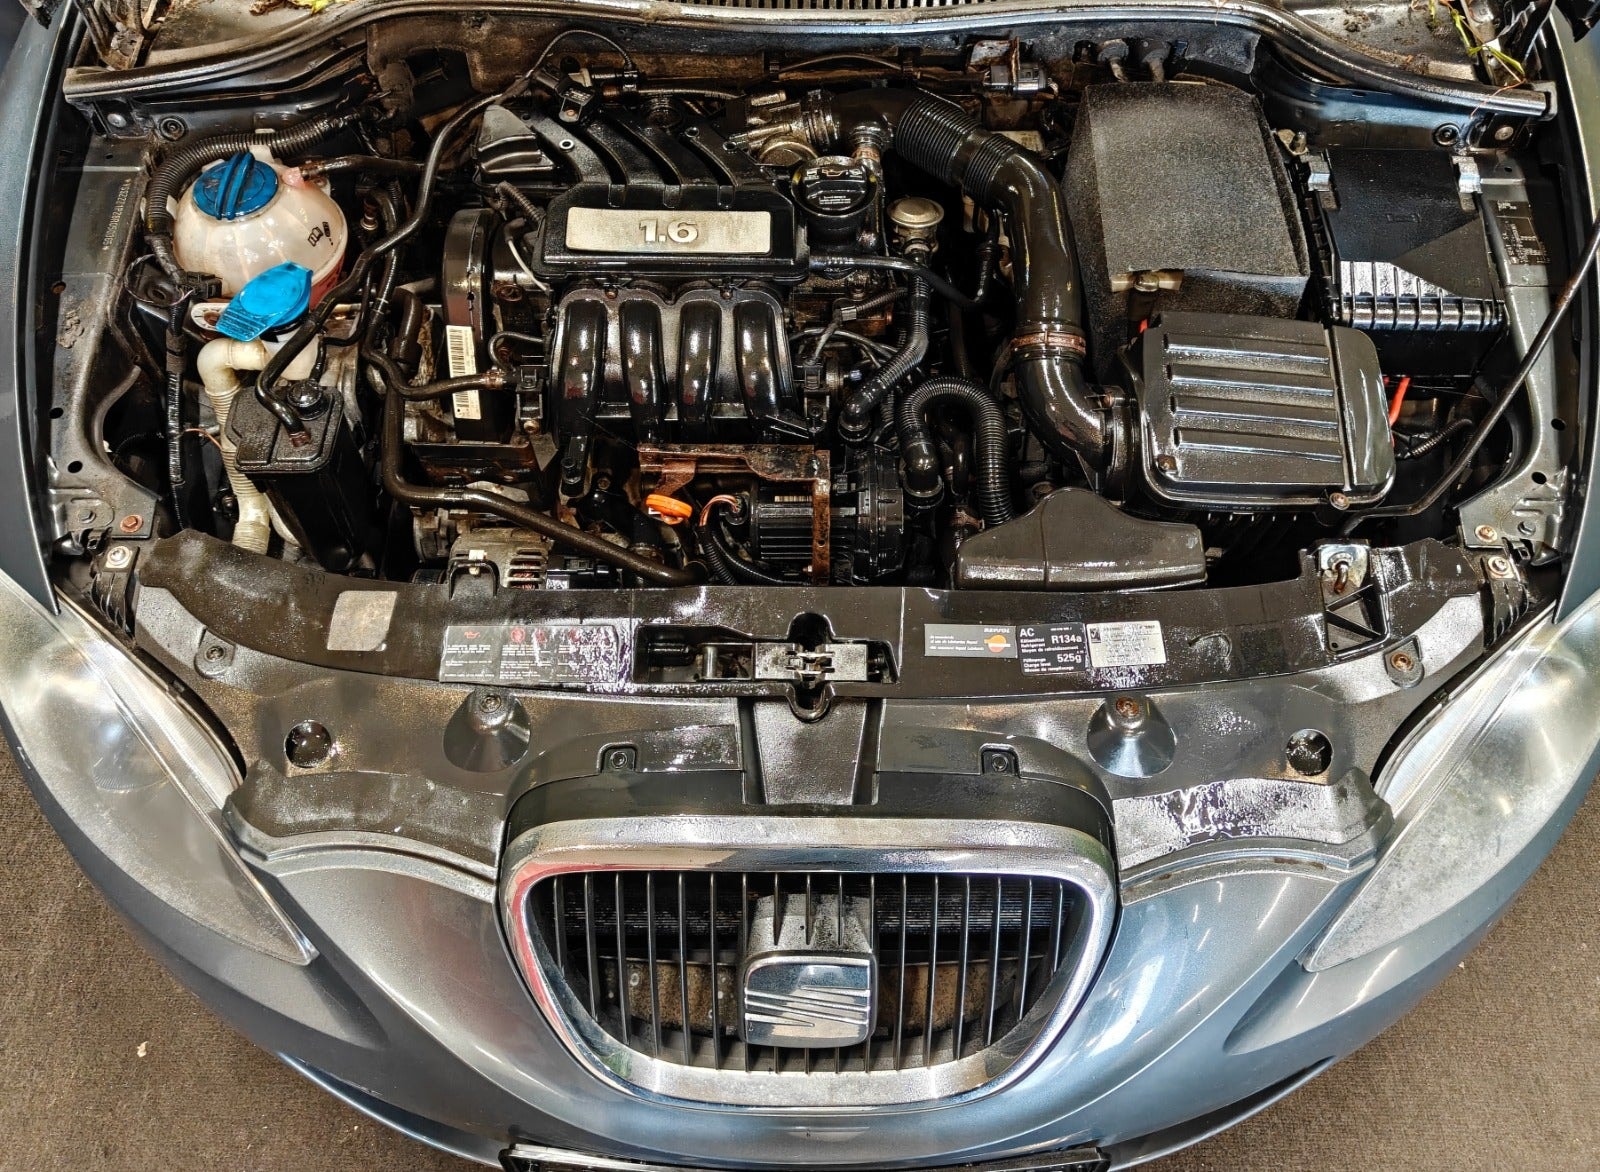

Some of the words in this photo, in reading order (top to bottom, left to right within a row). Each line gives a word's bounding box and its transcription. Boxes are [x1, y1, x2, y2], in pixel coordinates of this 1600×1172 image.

[639, 218, 699, 243] 1.6
[1020, 627, 1035, 637] AC
[1051, 634, 1083, 644] R134a
[1057, 653, 1082, 664] 525g
